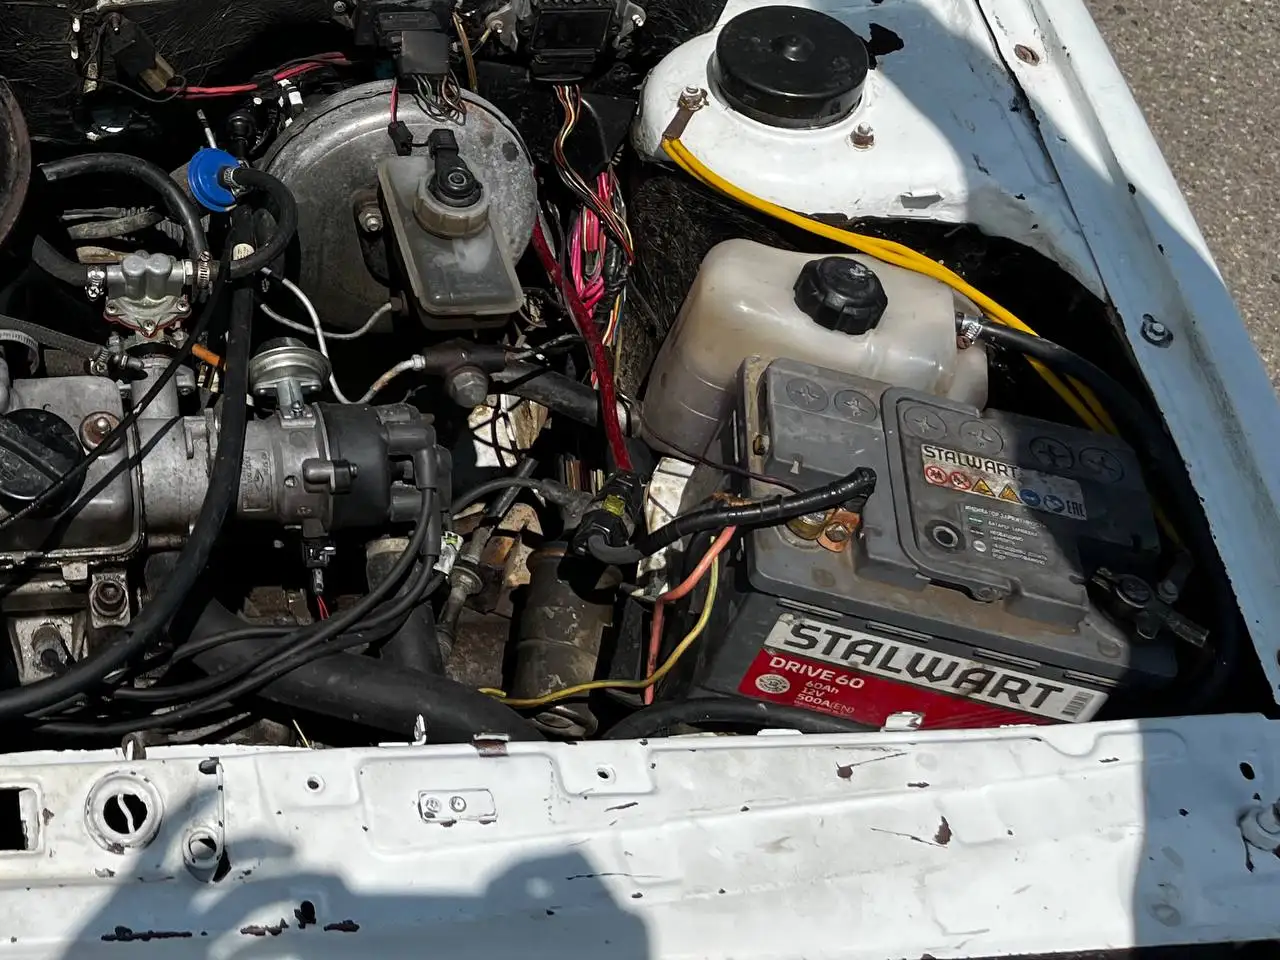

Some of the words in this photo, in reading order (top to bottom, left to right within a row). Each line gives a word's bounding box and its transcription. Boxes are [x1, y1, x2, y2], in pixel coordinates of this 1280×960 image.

[924, 446, 1018, 478] STALWART
[769, 657, 836, 681] DRIVE
[835, 675, 865, 689] 60
[784, 623, 1067, 709] STALWART
[801, 687, 826, 697] 12V
[805, 680, 840, 694] 60Ah
